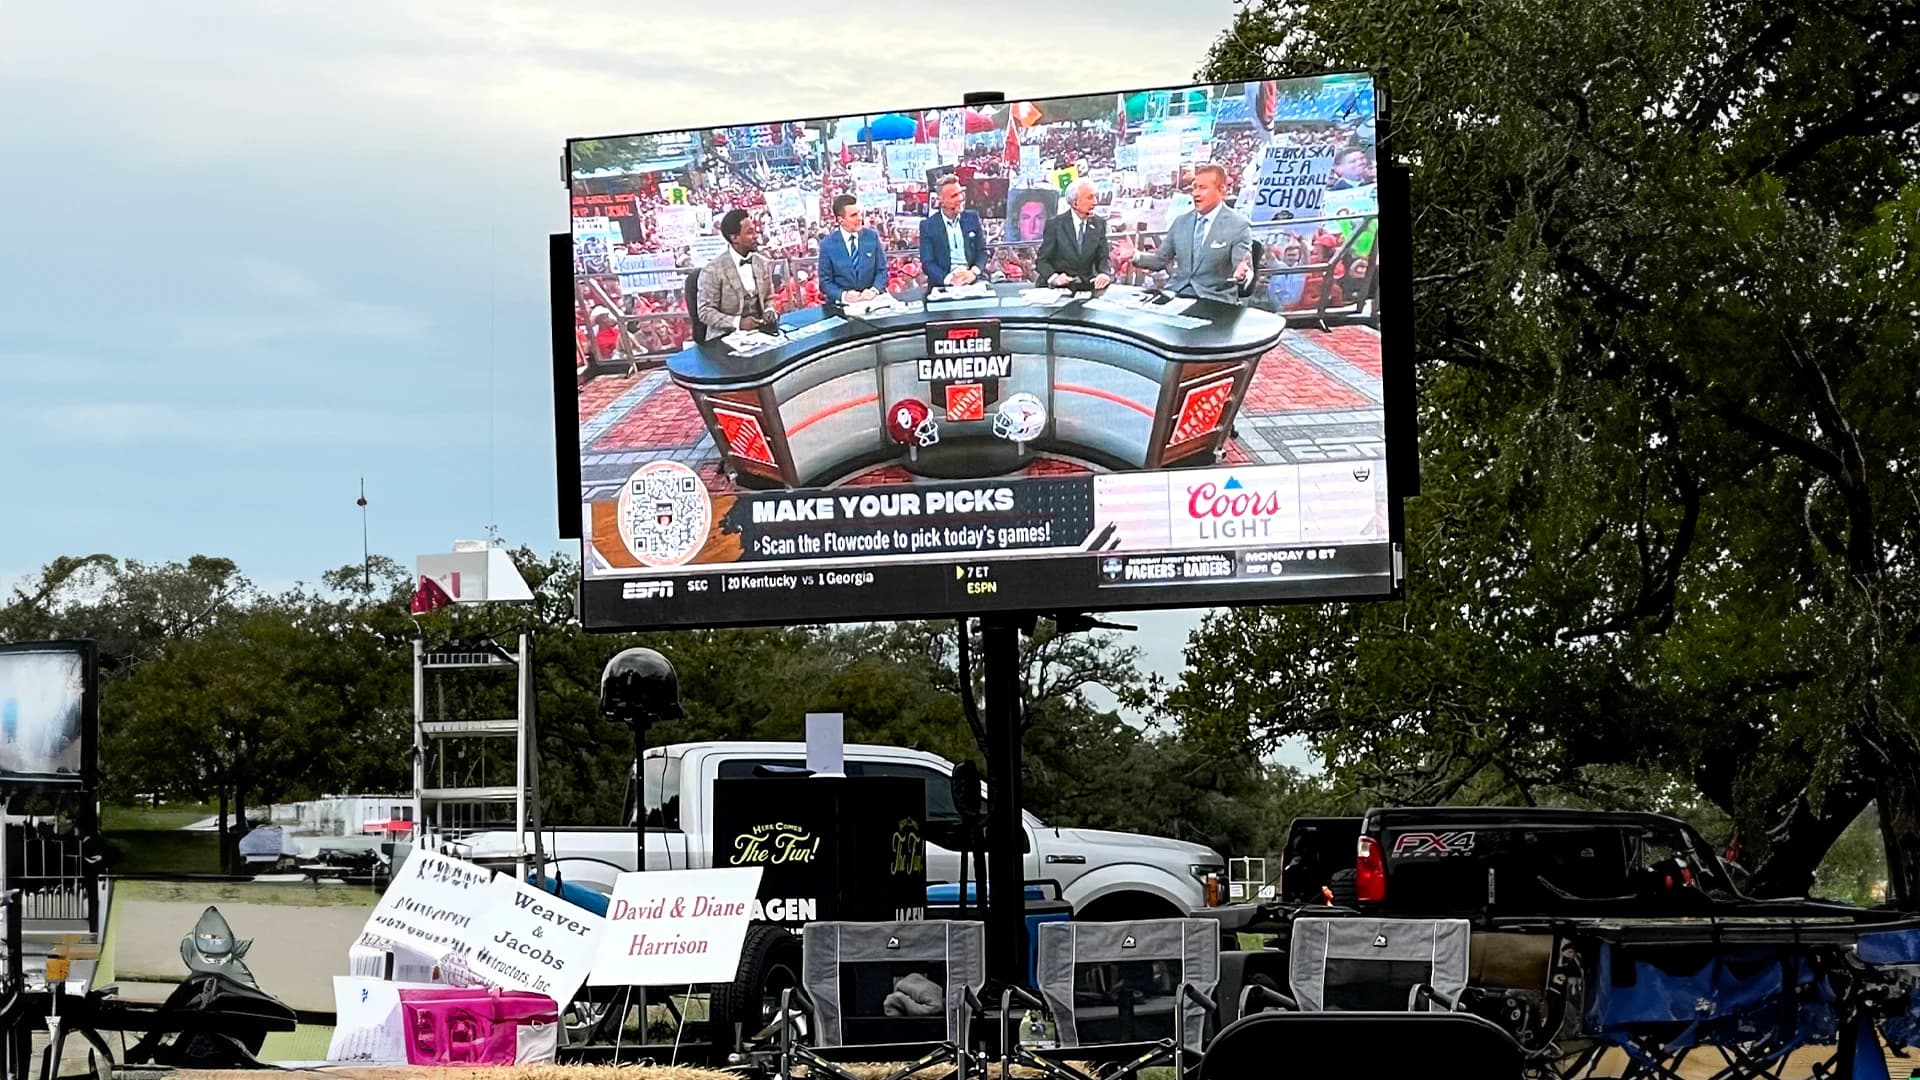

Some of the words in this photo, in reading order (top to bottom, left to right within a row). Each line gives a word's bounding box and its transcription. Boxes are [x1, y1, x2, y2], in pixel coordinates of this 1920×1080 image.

[1265, 145, 1335, 159] NEBRASKA
[1273, 160, 1297, 174] IS
[1300, 160, 1311, 174] A
[1259, 174, 1327, 187] VOLLEYBALL
[1256, 188, 1322, 209] SCHOOL
[934, 337, 992, 355] COLLEGE
[919, 355, 1011, 380] GAMEDAY
[752, 497, 834, 524] MAKE
[838, 493, 921, 519] YOUR
[925, 487, 1014, 515] PICKS
[1187, 482, 1281, 519] Coors
[761, 535, 796, 555] Scan
[798, 533, 821, 553] the
[824, 530, 890, 552] Flowcode
[893, 529, 908, 549] to
[911, 527, 942, 552] pick
[944, 524, 995, 549] today's
[998, 521, 1051, 548] games!
[1199, 518, 1272, 540] LIGHT
[1245, 550, 1304, 562] MONDAY
[967, 567, 974, 579] 7
[976, 566, 990, 578] ET
[1125, 564, 1176, 580] PACKERS
[1183, 560, 1231, 577] RAIDERS
[622, 580, 674, 600] ESPN
[687, 579, 709, 592] SEC
[727, 577, 740, 590] 20
[741, 574, 798, 590] Kentucky
[802, 575, 814, 586] vs
[826, 571, 875, 587] Georgia
[967, 581, 997, 594] ESPN
[730, 833, 770, 865] The
[771, 832, 821, 865] Fun!
[1393, 831, 1476, 853] FX4
[514, 891, 591, 936] Weaver
[612, 897, 666, 921] David
[669, 896, 686, 918] &
[691, 895, 745, 918] Diane
[532, 926, 544, 938] &
[494, 931, 565, 970] Jacobs
[628, 933, 708, 956] Harrison
[531, 975, 551, 992] Inc
